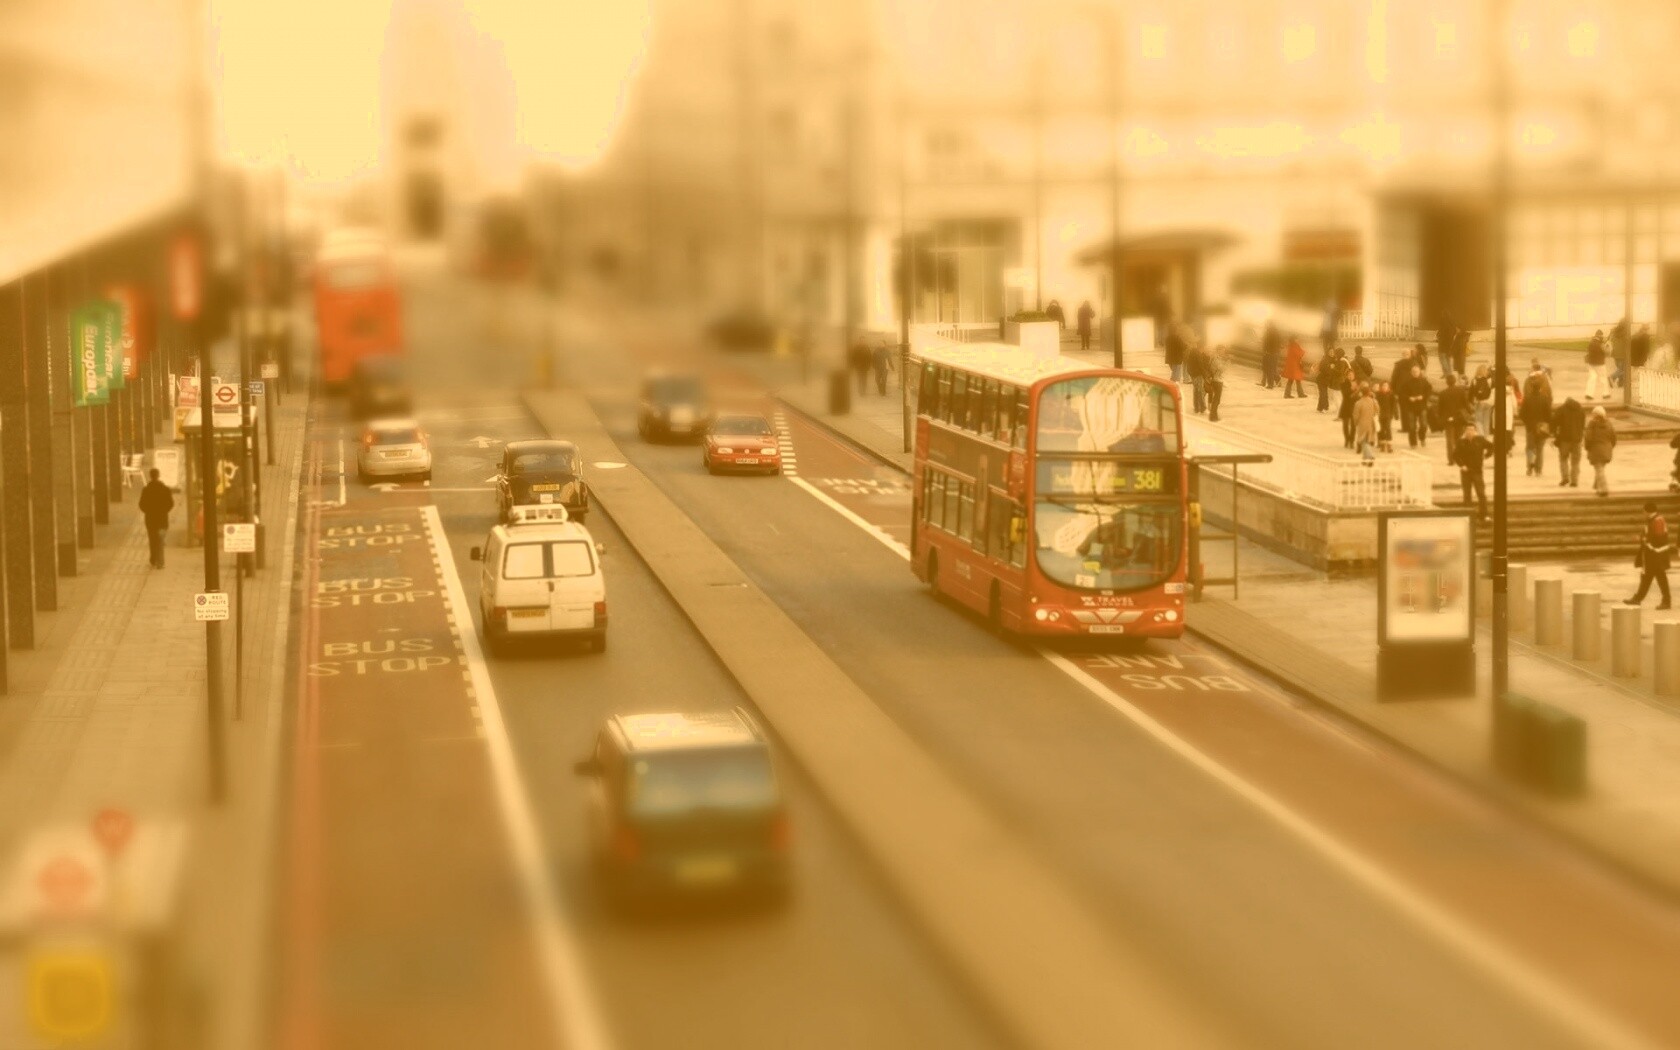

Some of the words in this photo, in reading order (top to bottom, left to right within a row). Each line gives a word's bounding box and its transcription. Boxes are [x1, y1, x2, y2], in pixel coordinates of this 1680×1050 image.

[83, 325, 98, 395] Europcar
[1133, 470, 1160, 489] 381
[327, 523, 411, 537] BUS
[318, 534, 422, 549] STOP
[318, 577, 414, 594] BUS
[309, 590, 435, 609] STOP
[323, 638, 434, 657] BUS
[307, 656, 452, 677] STOP
[1120, 674, 1251, 692] BUS
